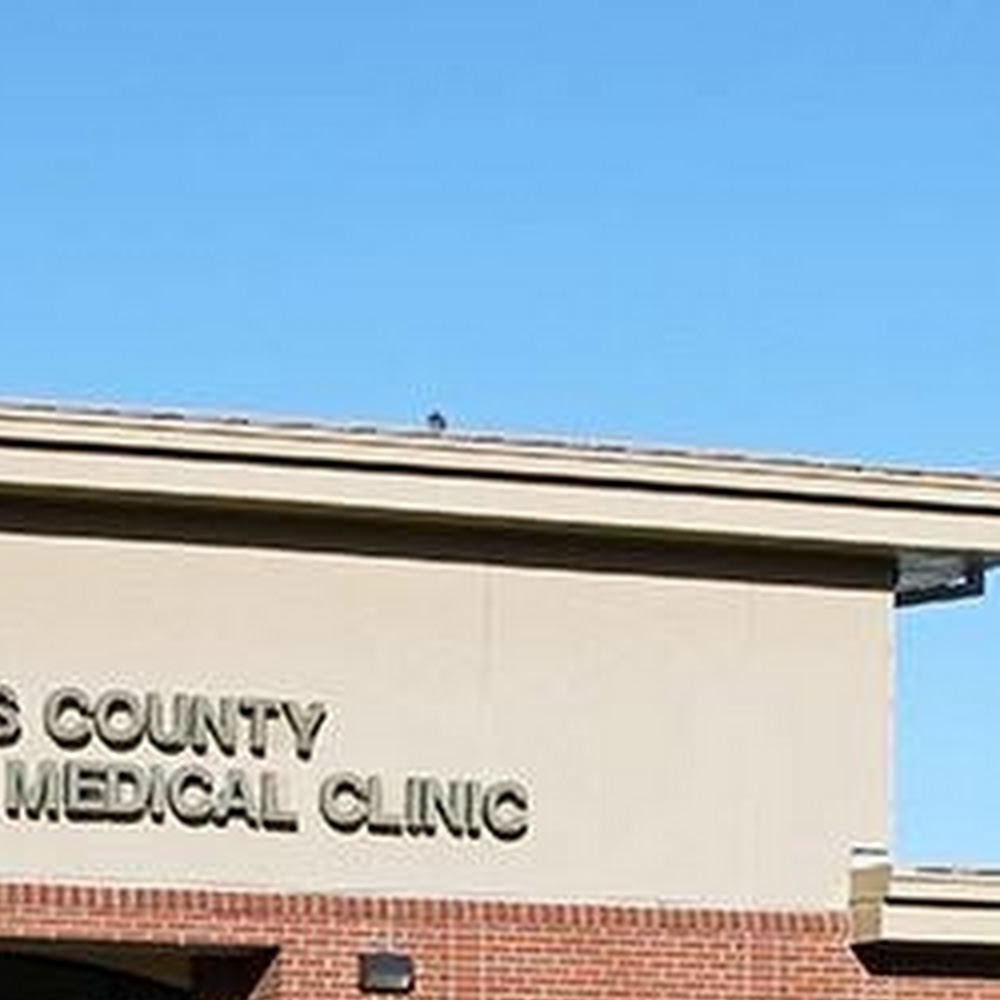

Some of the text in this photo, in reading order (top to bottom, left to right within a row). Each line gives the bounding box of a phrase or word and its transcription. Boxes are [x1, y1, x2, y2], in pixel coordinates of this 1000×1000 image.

[43, 686, 327, 760] COUNTY
[5, 759, 299, 833] MEDICAL
[317, 774, 529, 842] CLINIC
